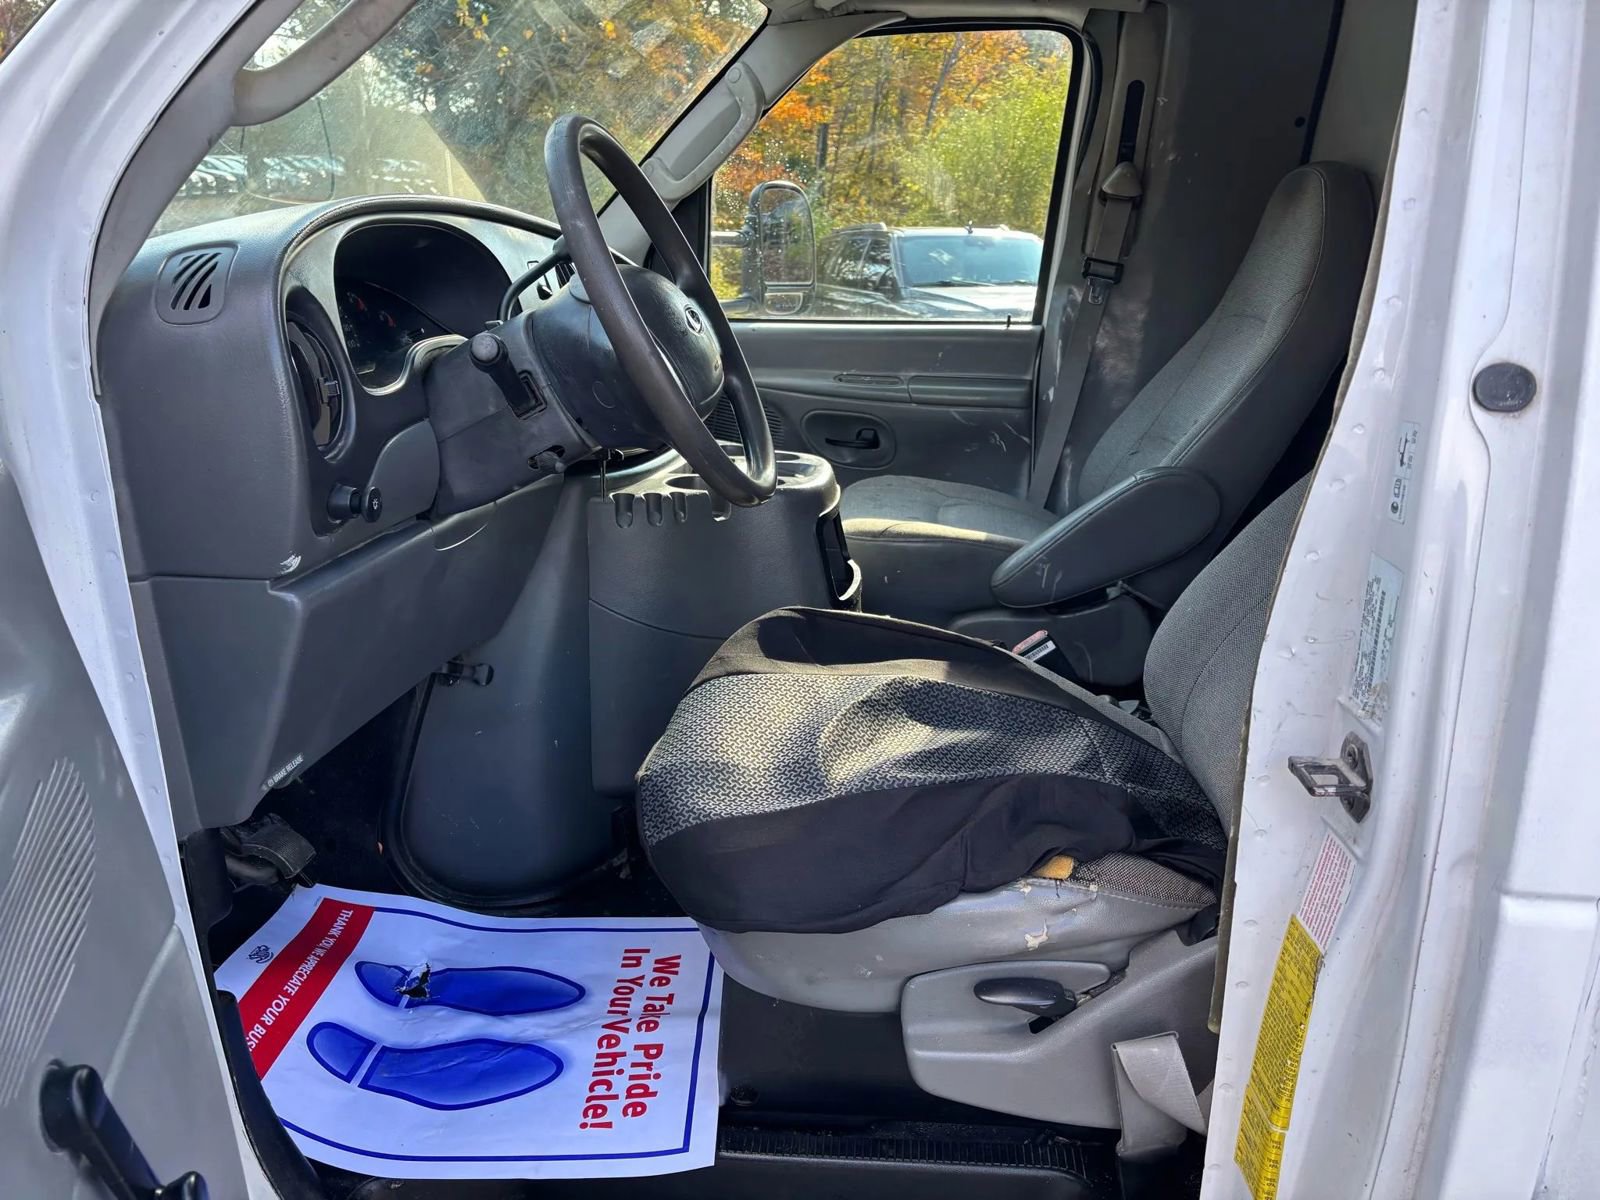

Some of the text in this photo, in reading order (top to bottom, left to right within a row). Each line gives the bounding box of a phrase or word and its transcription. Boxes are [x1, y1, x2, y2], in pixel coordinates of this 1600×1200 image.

[328, 910, 353, 938] THANK
[283, 954, 320, 997] APPRECIATE
[261, 994, 291, 1026] YOUR
[246, 1027, 266, 1052] BUS
[579, 948, 650, 1130] In Your Vehicle!
[622, 955, 682, 1117] We Take Pride
